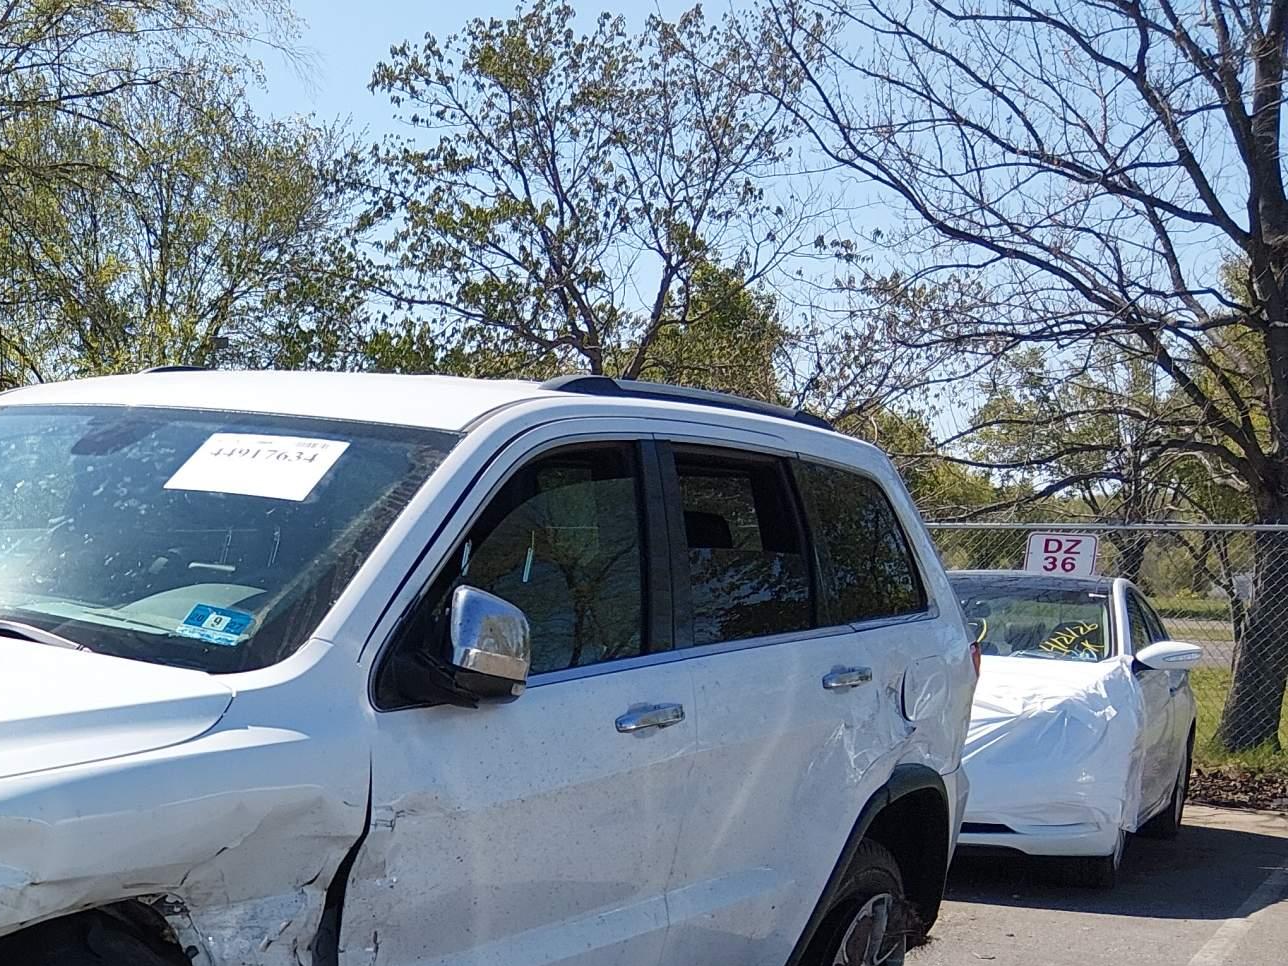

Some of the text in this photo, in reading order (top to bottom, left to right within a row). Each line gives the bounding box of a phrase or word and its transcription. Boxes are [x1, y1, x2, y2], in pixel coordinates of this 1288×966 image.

[210, 447, 319, 463] 44917634
[1043, 538, 1082, 555] DZ
[1042, 556, 1076, 572] 36
